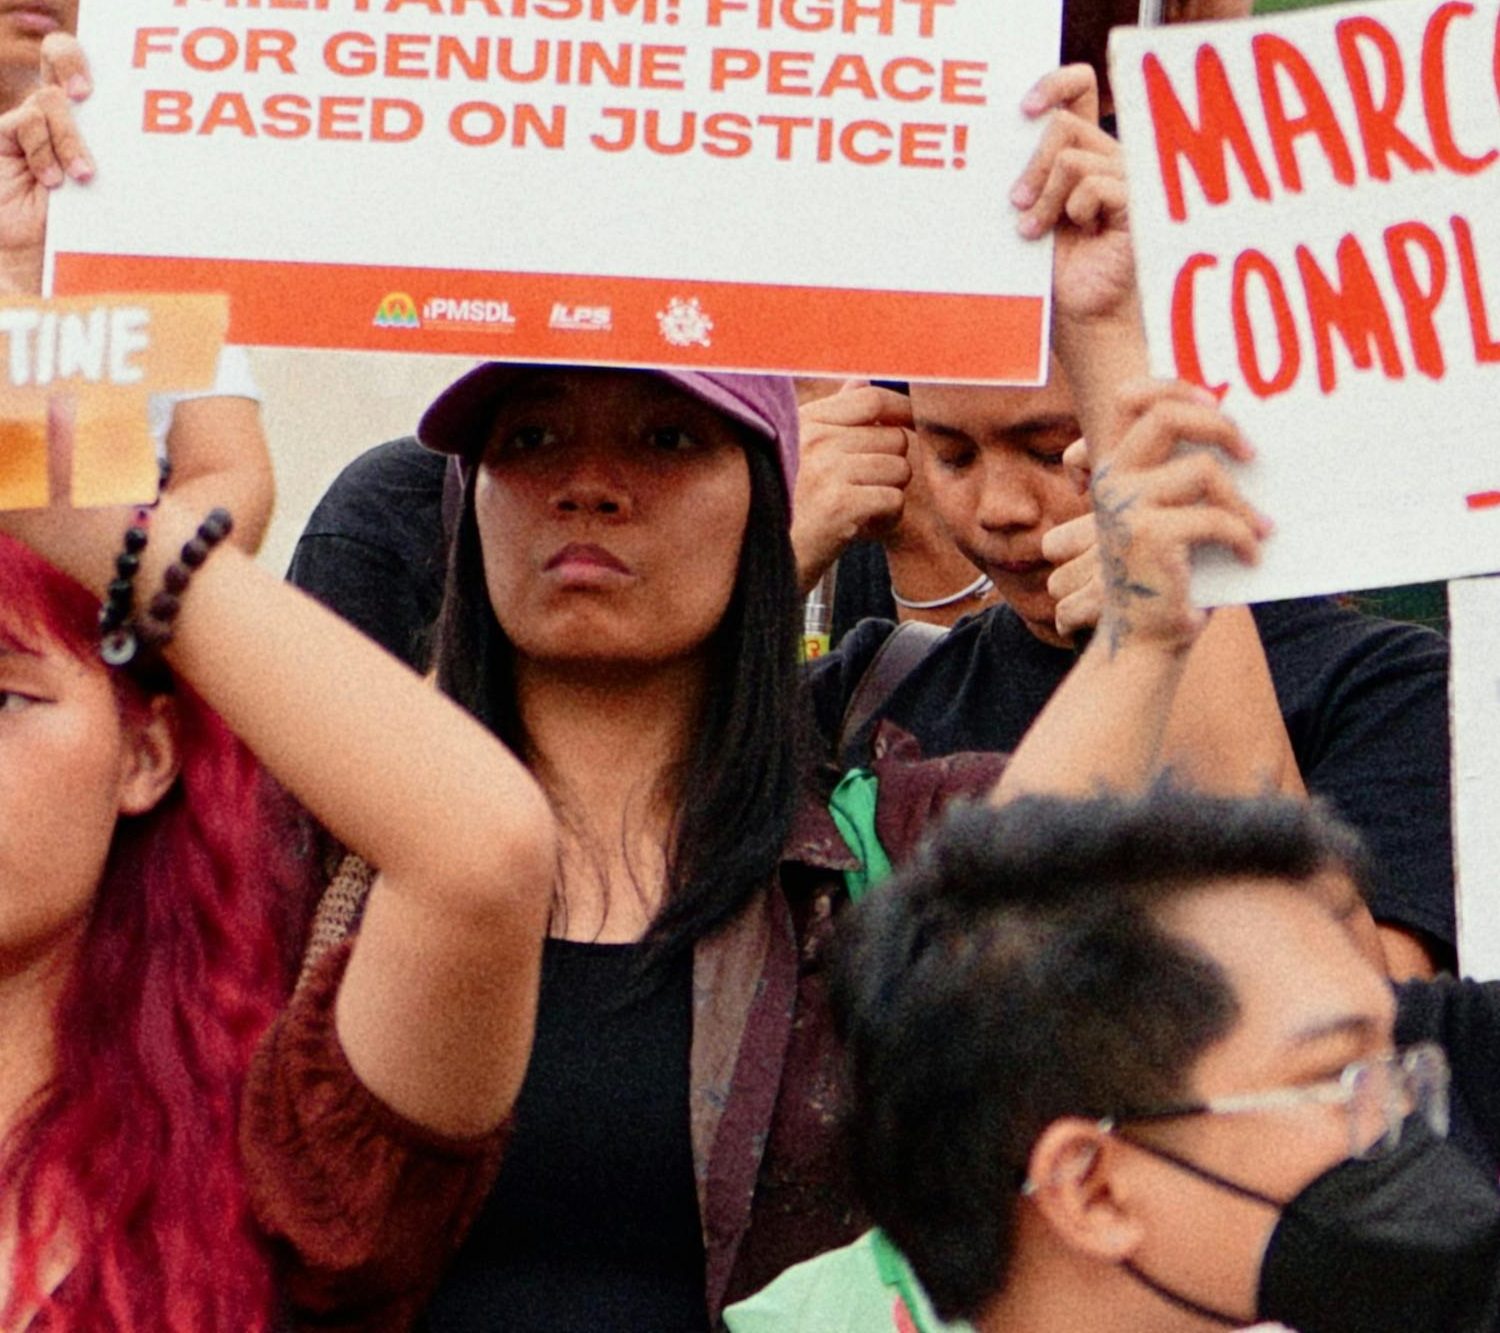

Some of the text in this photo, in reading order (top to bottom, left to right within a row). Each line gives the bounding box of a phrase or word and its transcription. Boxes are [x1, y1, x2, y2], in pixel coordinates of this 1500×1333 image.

[131, 25, 989, 106] FOR GENUINE PEACE
[141, 89, 969, 171] BASED ON JUSTICE!
